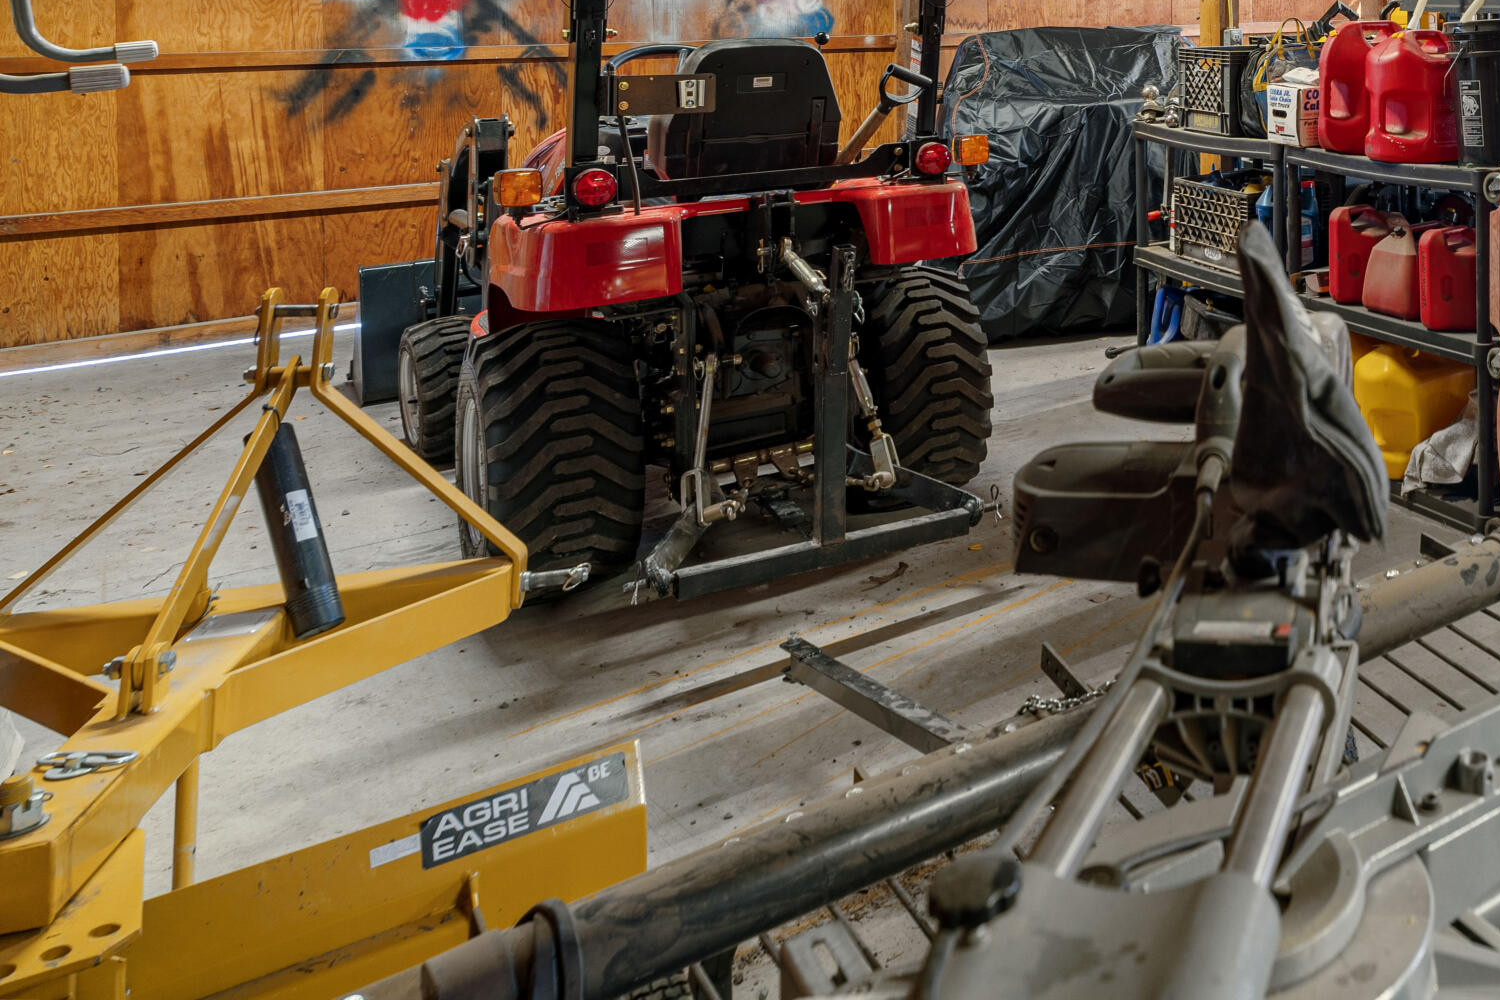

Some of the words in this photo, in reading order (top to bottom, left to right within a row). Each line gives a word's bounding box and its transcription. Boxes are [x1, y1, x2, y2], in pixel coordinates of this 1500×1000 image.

[1305, 90, 1320, 100] CO
[587, 760, 611, 783] BE
[432, 788, 529, 840] AGRI
[432, 811, 530, 862] EASE
